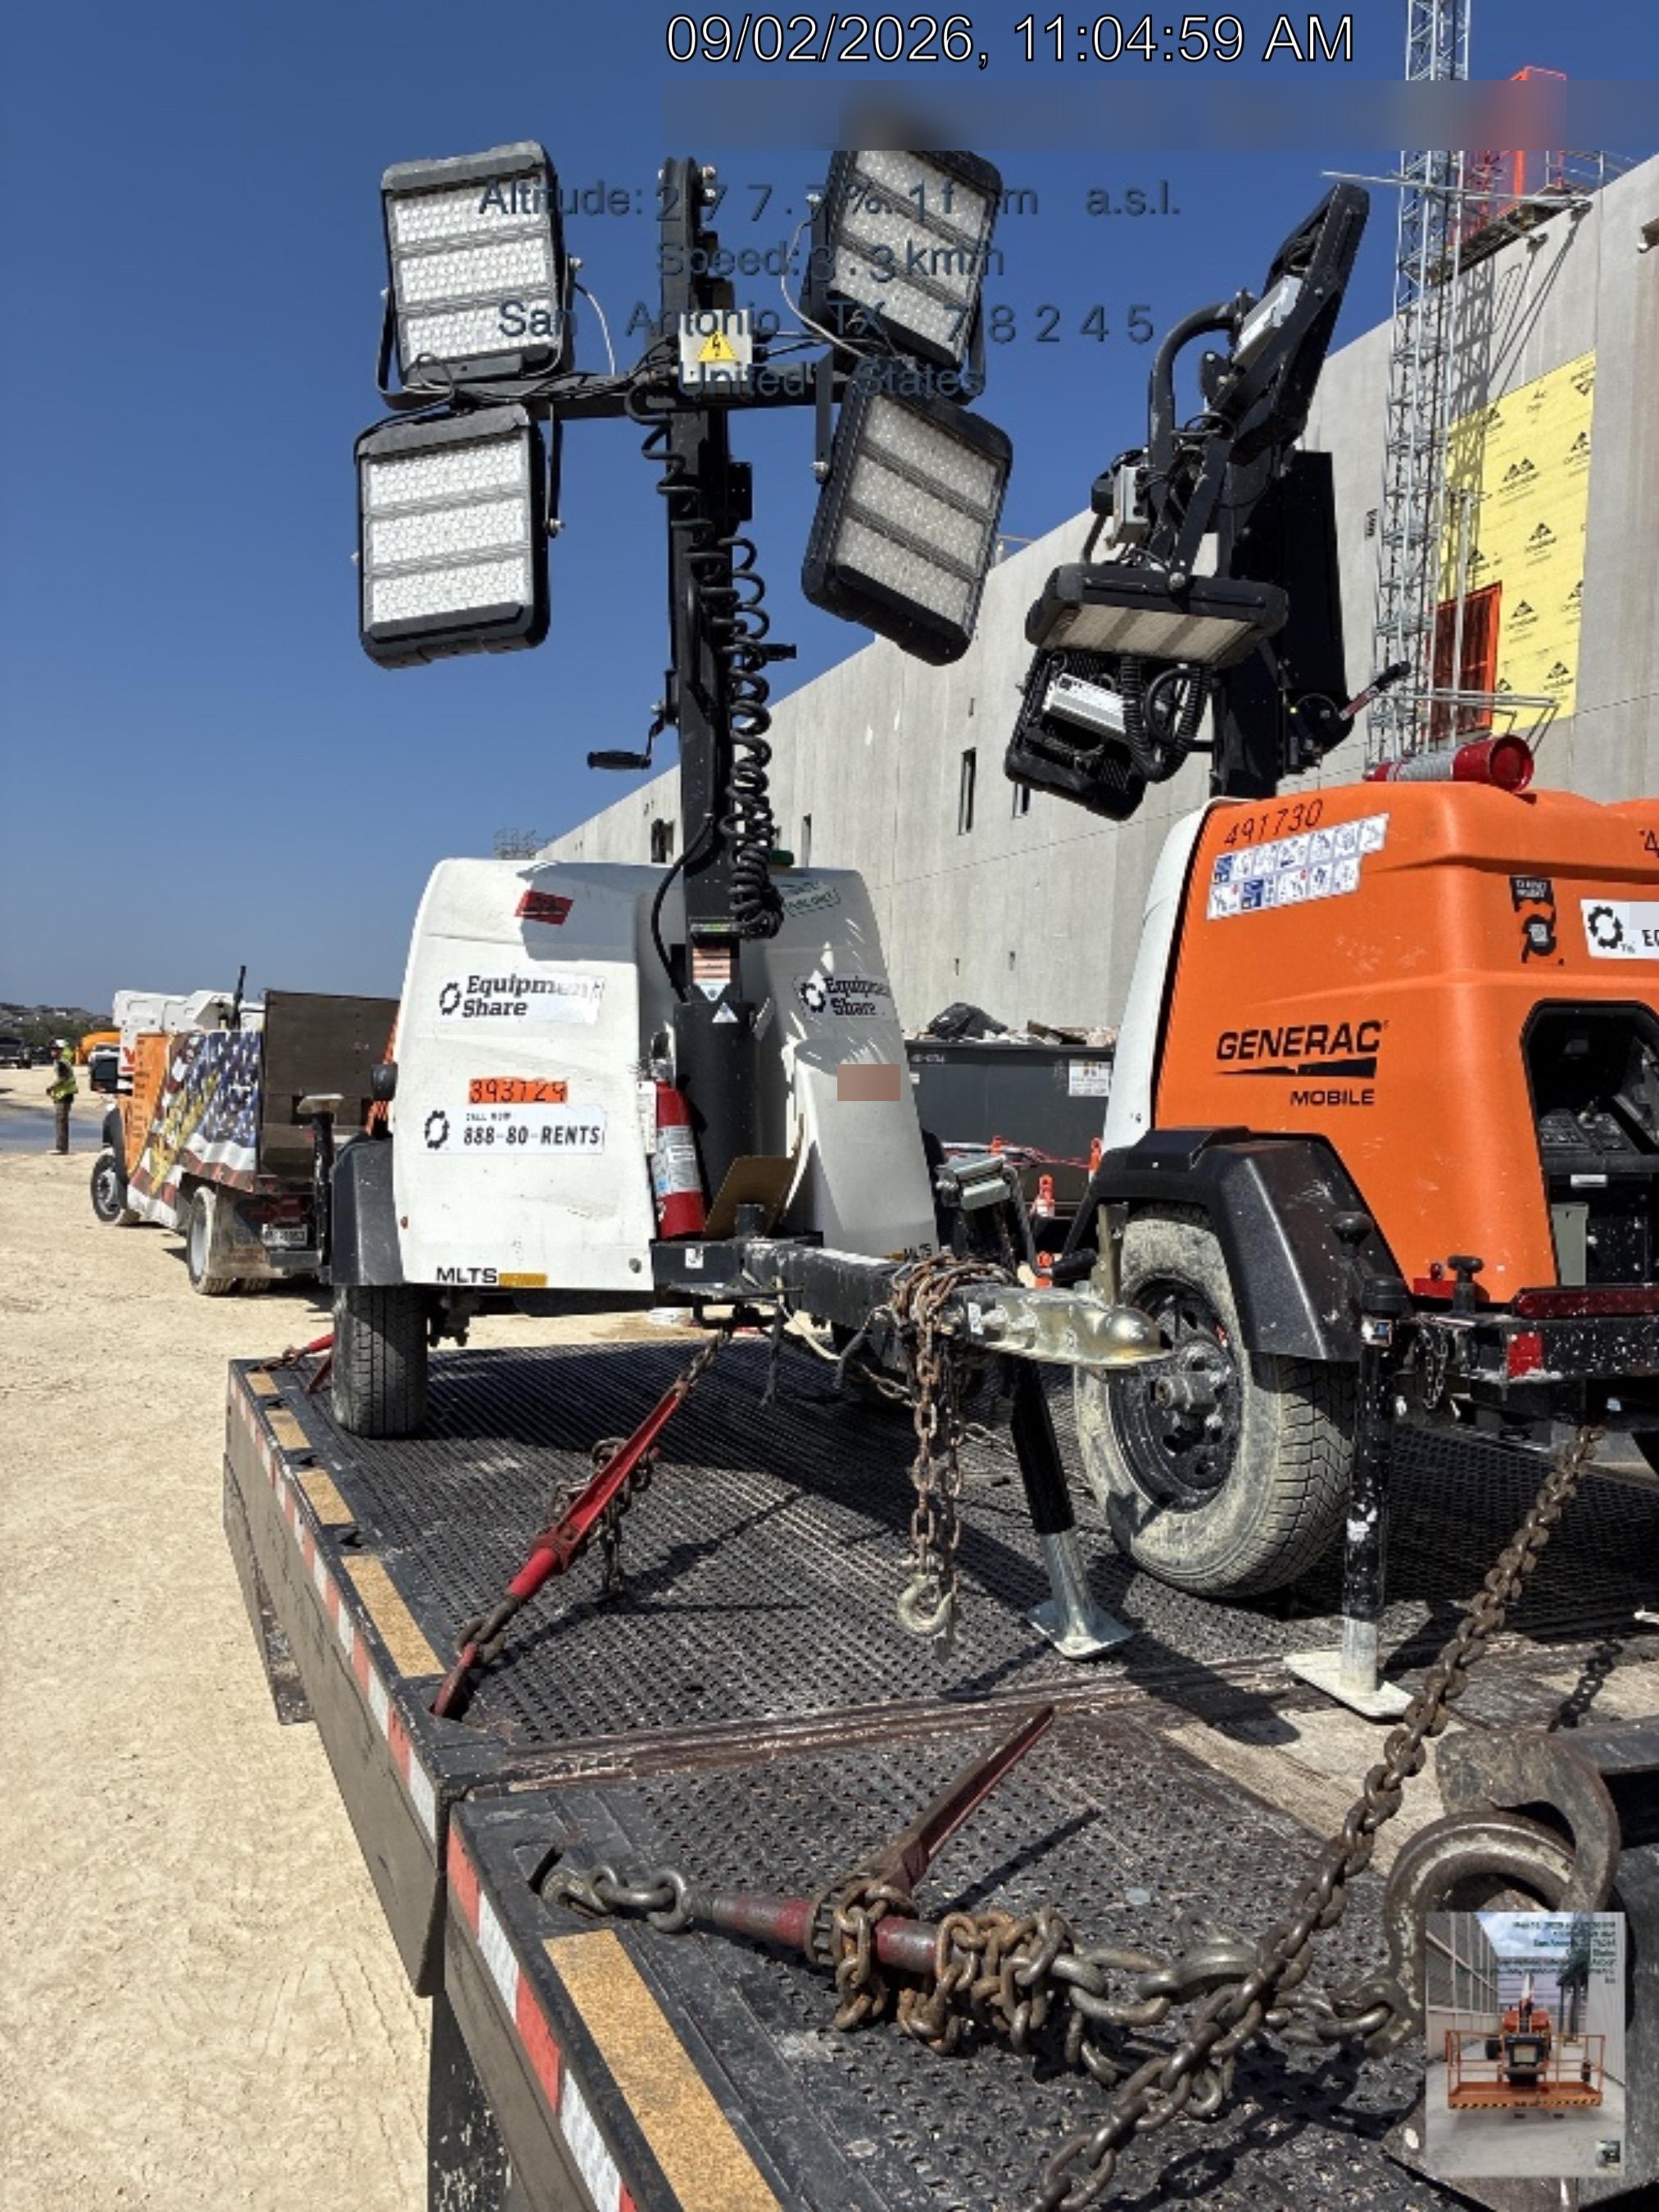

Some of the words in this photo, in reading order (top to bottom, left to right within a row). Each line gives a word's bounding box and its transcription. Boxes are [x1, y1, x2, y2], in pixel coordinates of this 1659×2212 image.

[1224, 799, 1324, 845] 491730
[462, 998, 528, 1018] Share
[830, 997, 877, 1016] Share
[1216, 1020, 1382, 1060] GENERAC
[1290, 1088, 1375, 1106] MOBILE
[464, 1125, 601, 1146] 888-80-RENTS
[436, 1267, 497, 1284] MLTS
